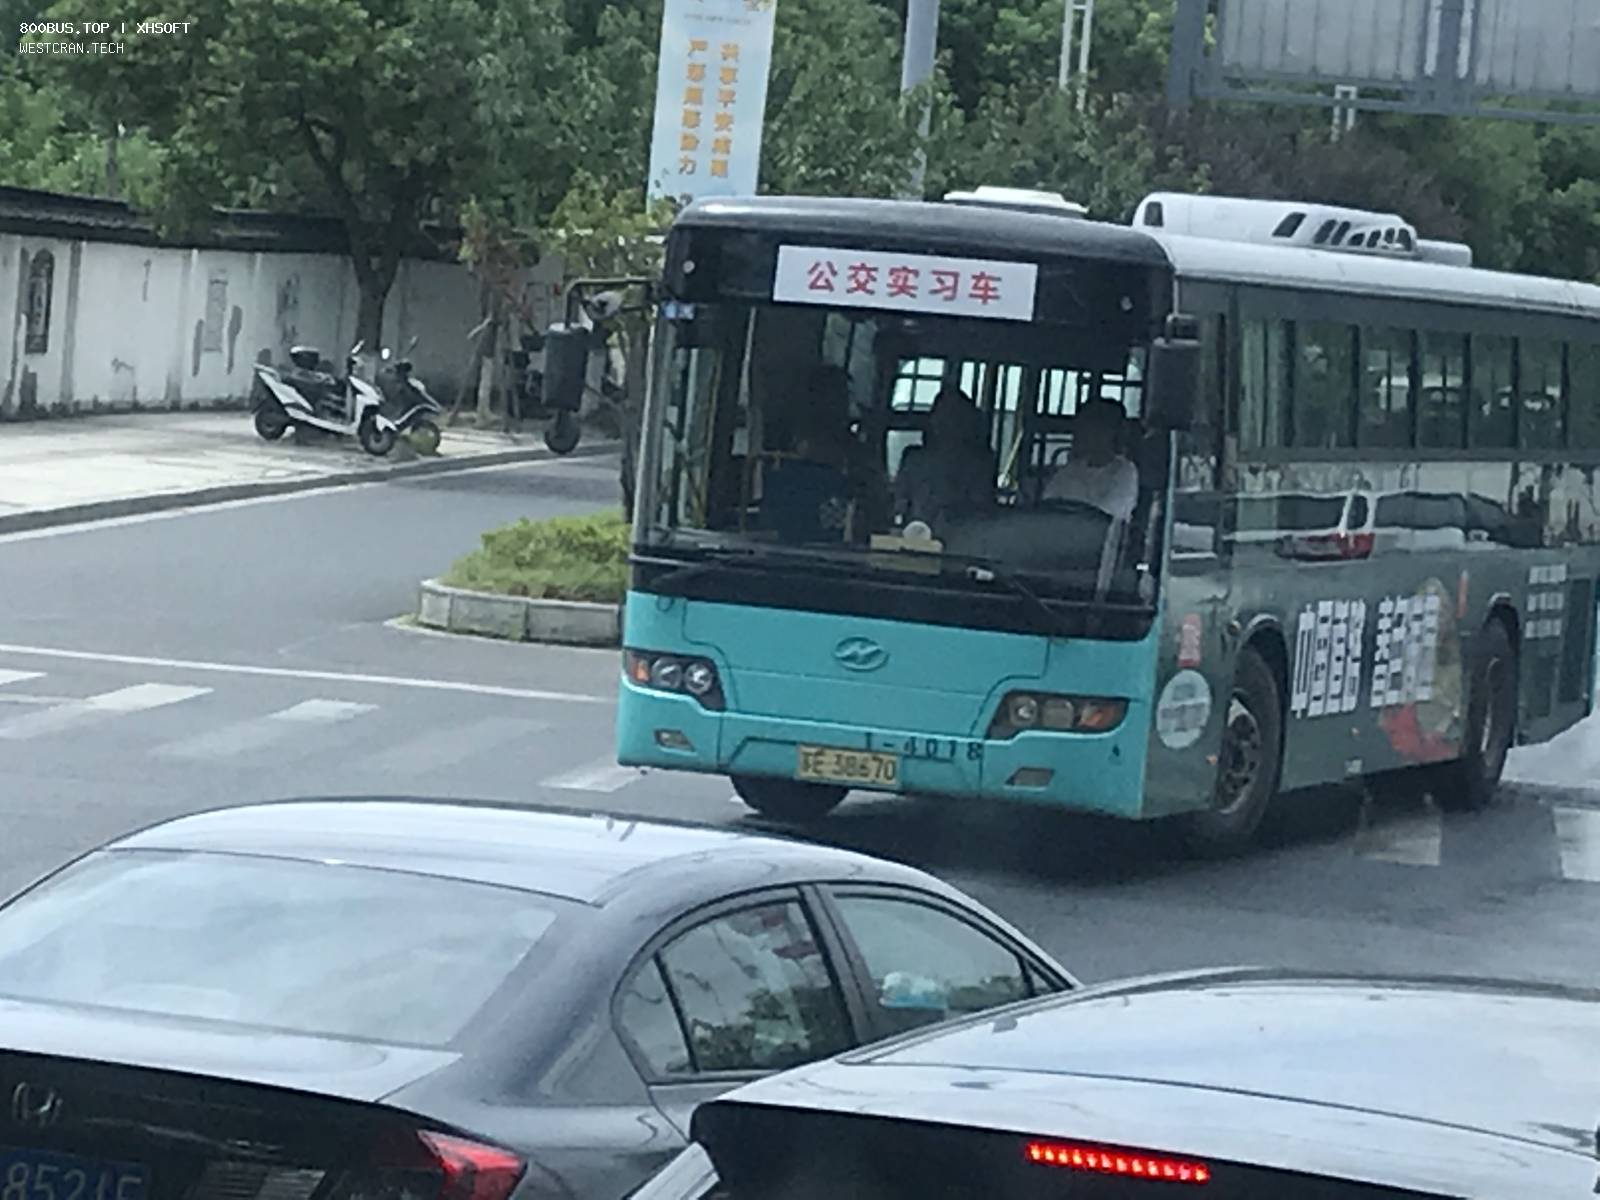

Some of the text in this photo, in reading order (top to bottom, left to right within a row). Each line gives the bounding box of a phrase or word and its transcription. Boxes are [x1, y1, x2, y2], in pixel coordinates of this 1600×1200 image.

[807, 260, 1003, 305] 公交实习车
